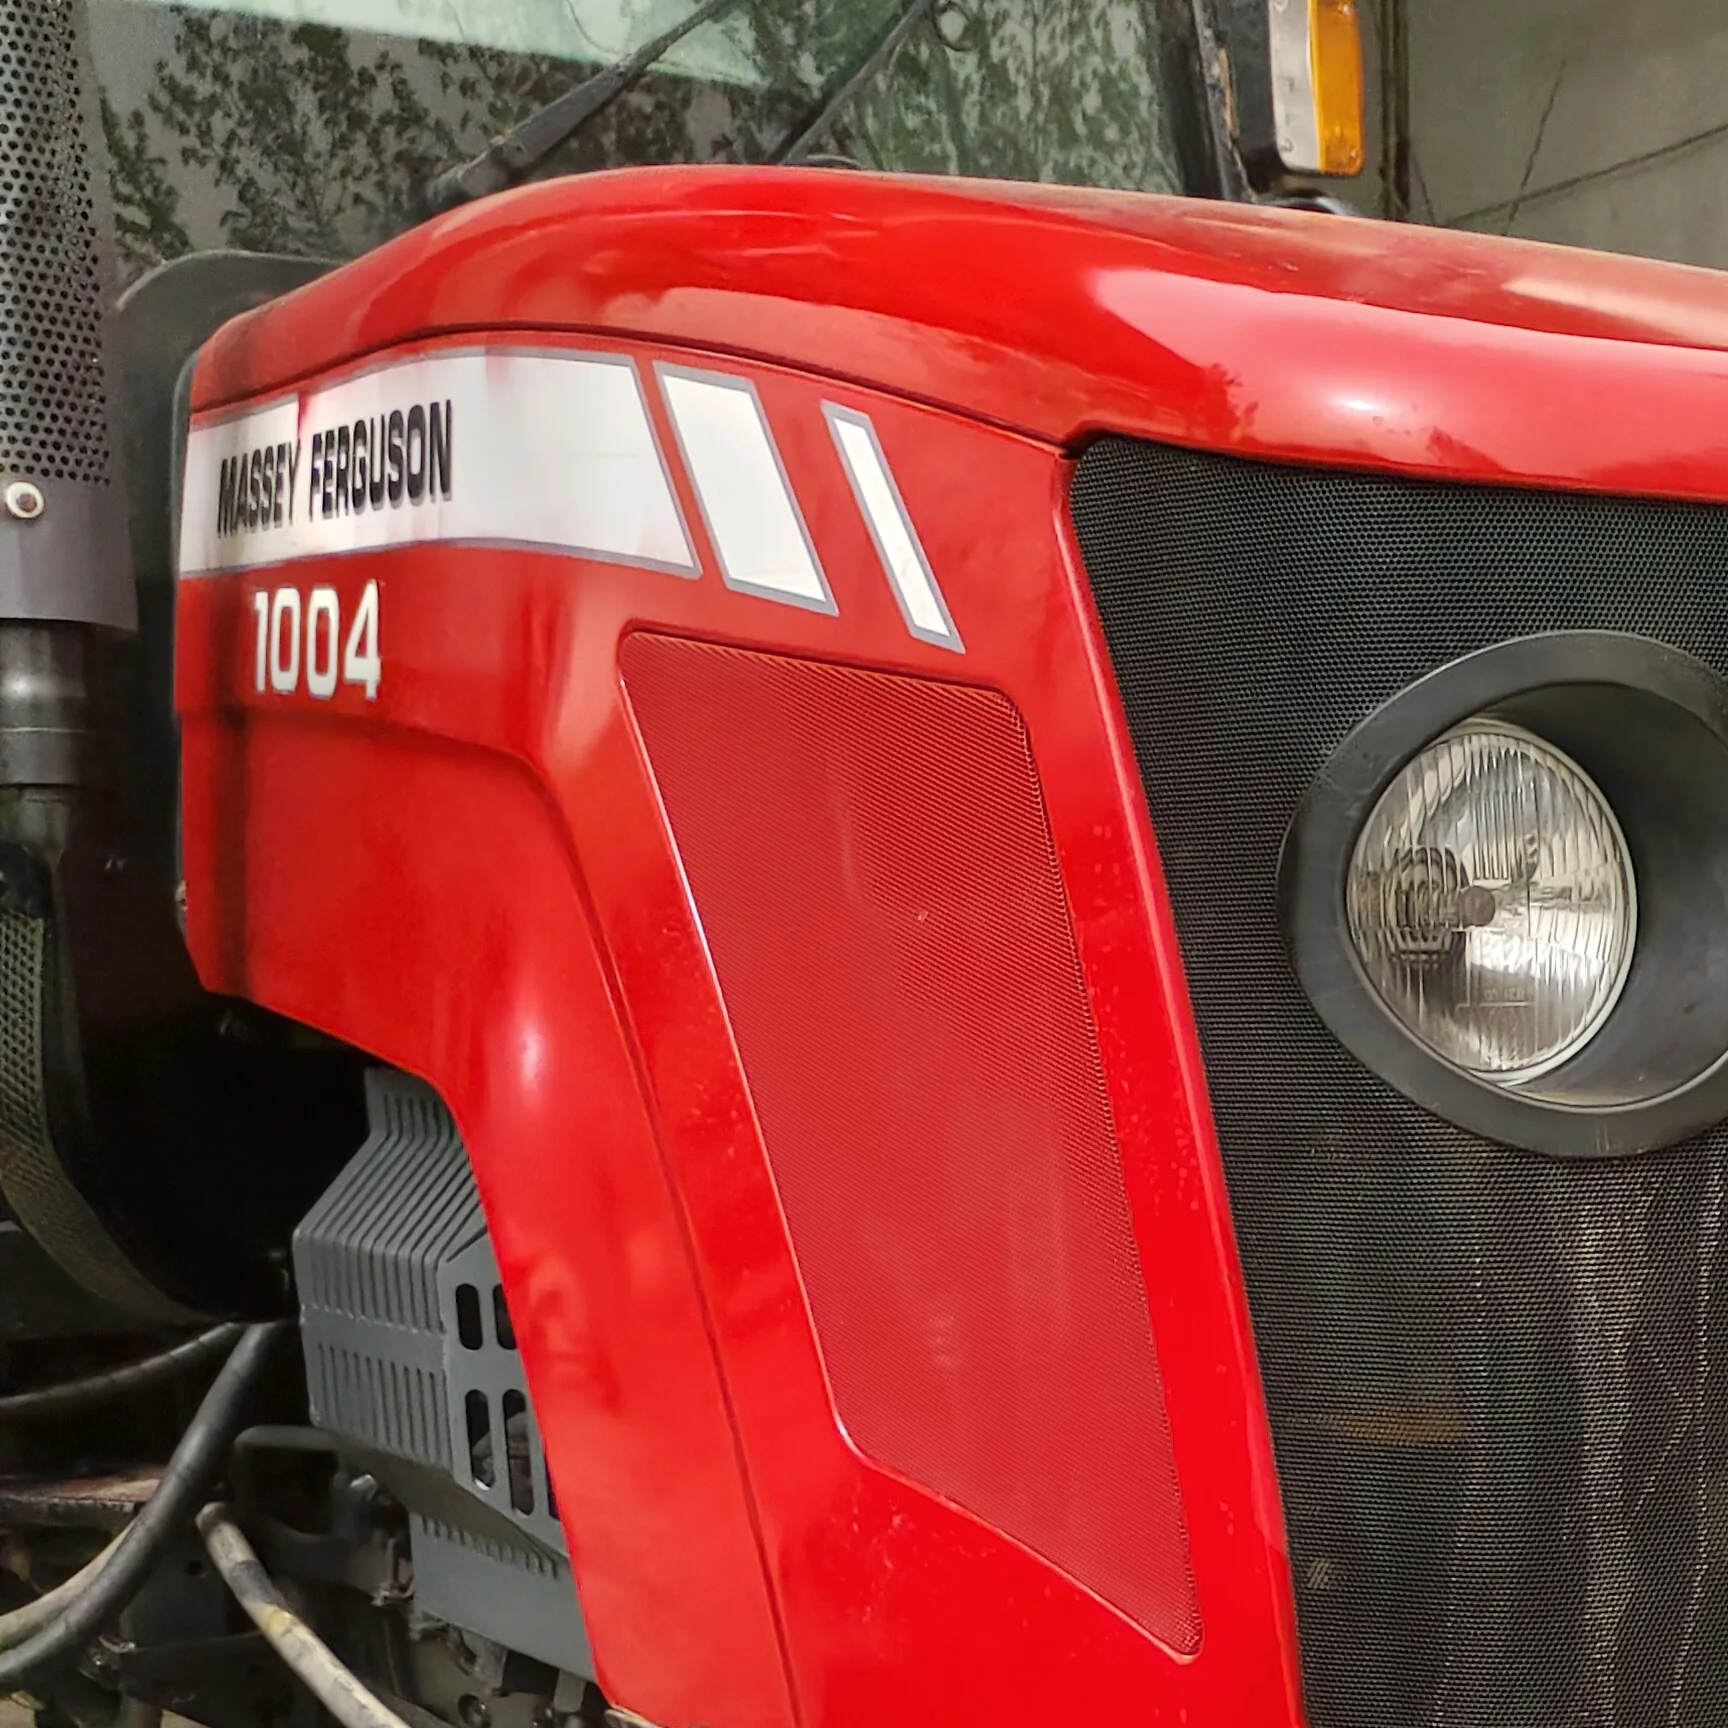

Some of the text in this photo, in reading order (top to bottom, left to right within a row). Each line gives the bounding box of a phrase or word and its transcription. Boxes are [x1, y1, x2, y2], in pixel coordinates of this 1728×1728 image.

[217, 398, 452, 539] MASSEY FERGUSON
[254, 578, 382, 702] 1004
